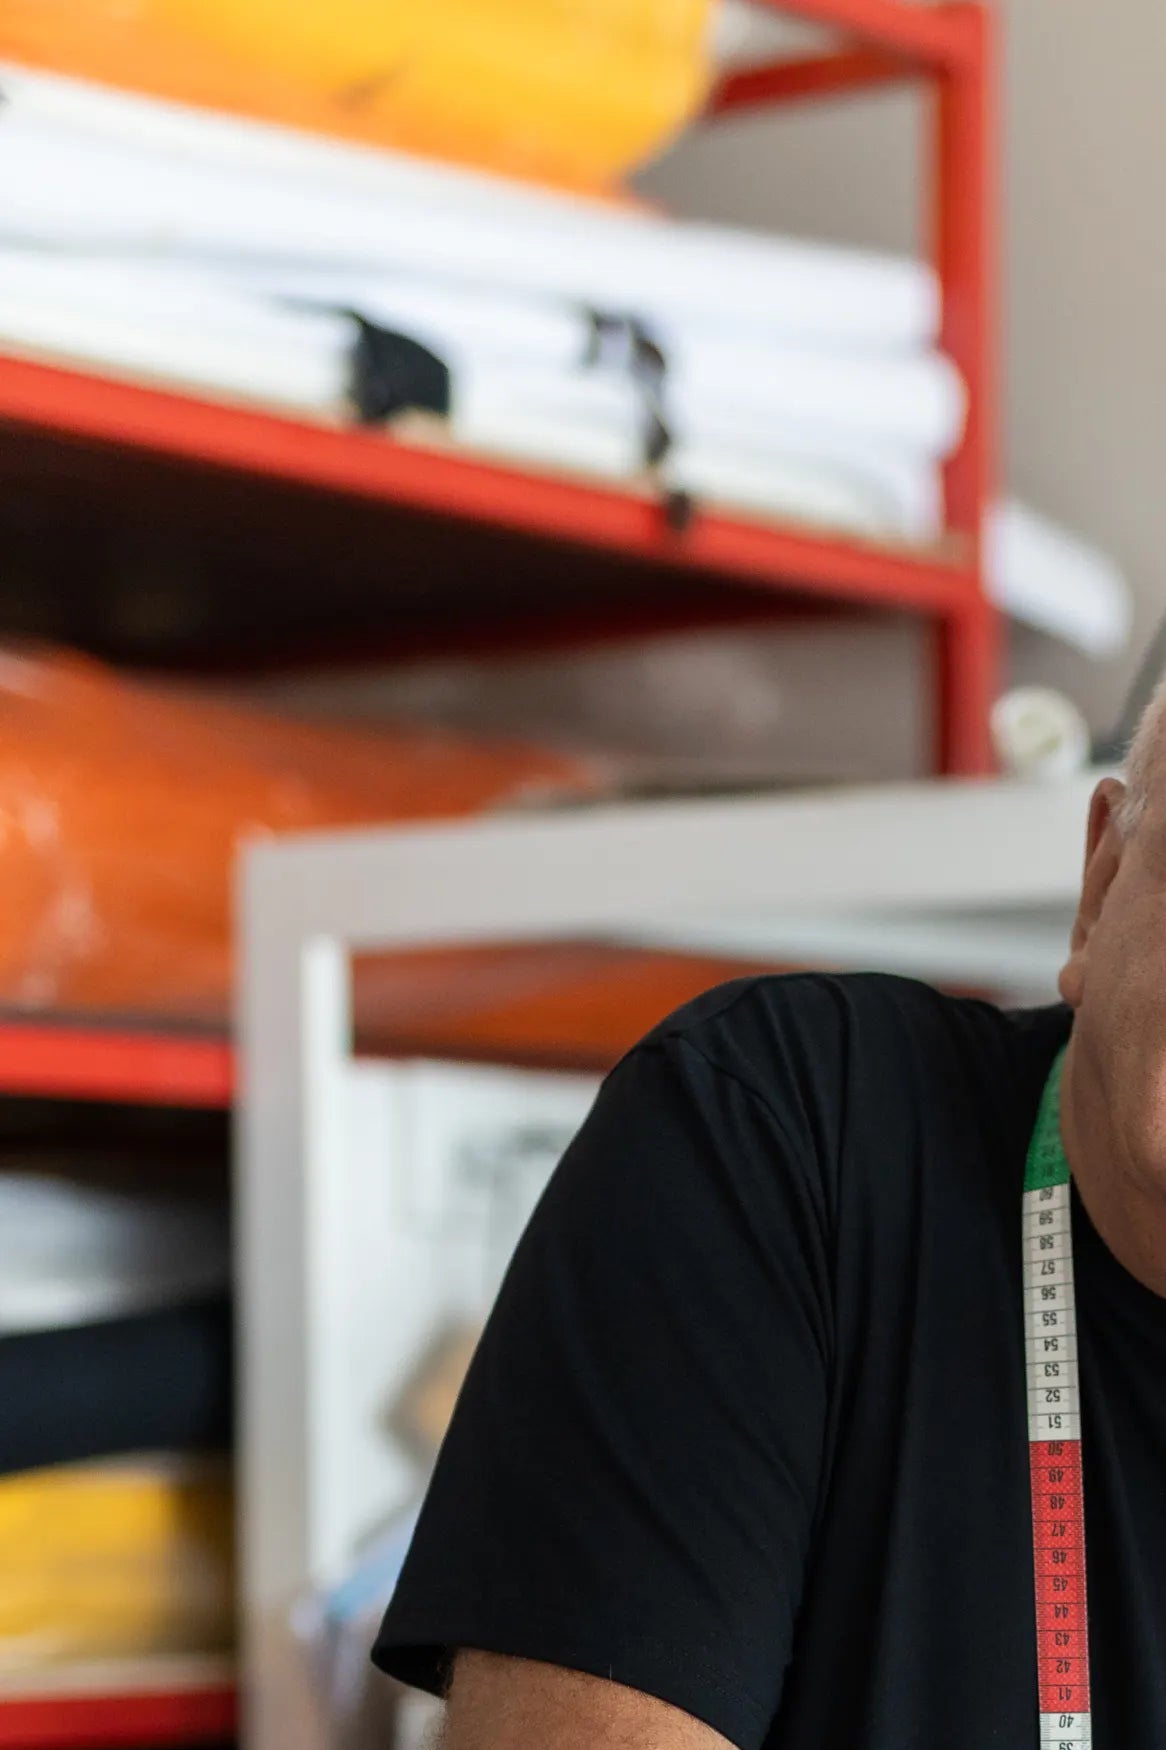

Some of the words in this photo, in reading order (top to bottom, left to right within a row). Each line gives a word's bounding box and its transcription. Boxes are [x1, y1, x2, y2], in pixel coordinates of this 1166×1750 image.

[1041, 1262, 1055, 1275] 57
[1041, 1287, 1056, 1300] 56
[1042, 1312, 1057, 1326] 55
[1044, 1338, 1059, 1351] 54
[1044, 1364, 1059, 1377] 53
[1045, 1389, 1061, 1403] 52
[1048, 1415, 1062, 1429] 51
[1049, 1469, 1064, 1483] 49
[1050, 1496, 1065, 1510] 48
[1052, 1524, 1066, 1537] 47
[1052, 1550, 1067, 1564] 46
[1053, 1577, 1068, 1591] 45
[1054, 1605, 1069, 1619] 44
[1055, 1633, 1070, 1646] 43
[1056, 1660, 1071, 1673] 42
[1059, 1687, 1072, 1701] 41
[1059, 1715, 1074, 1728] 40
